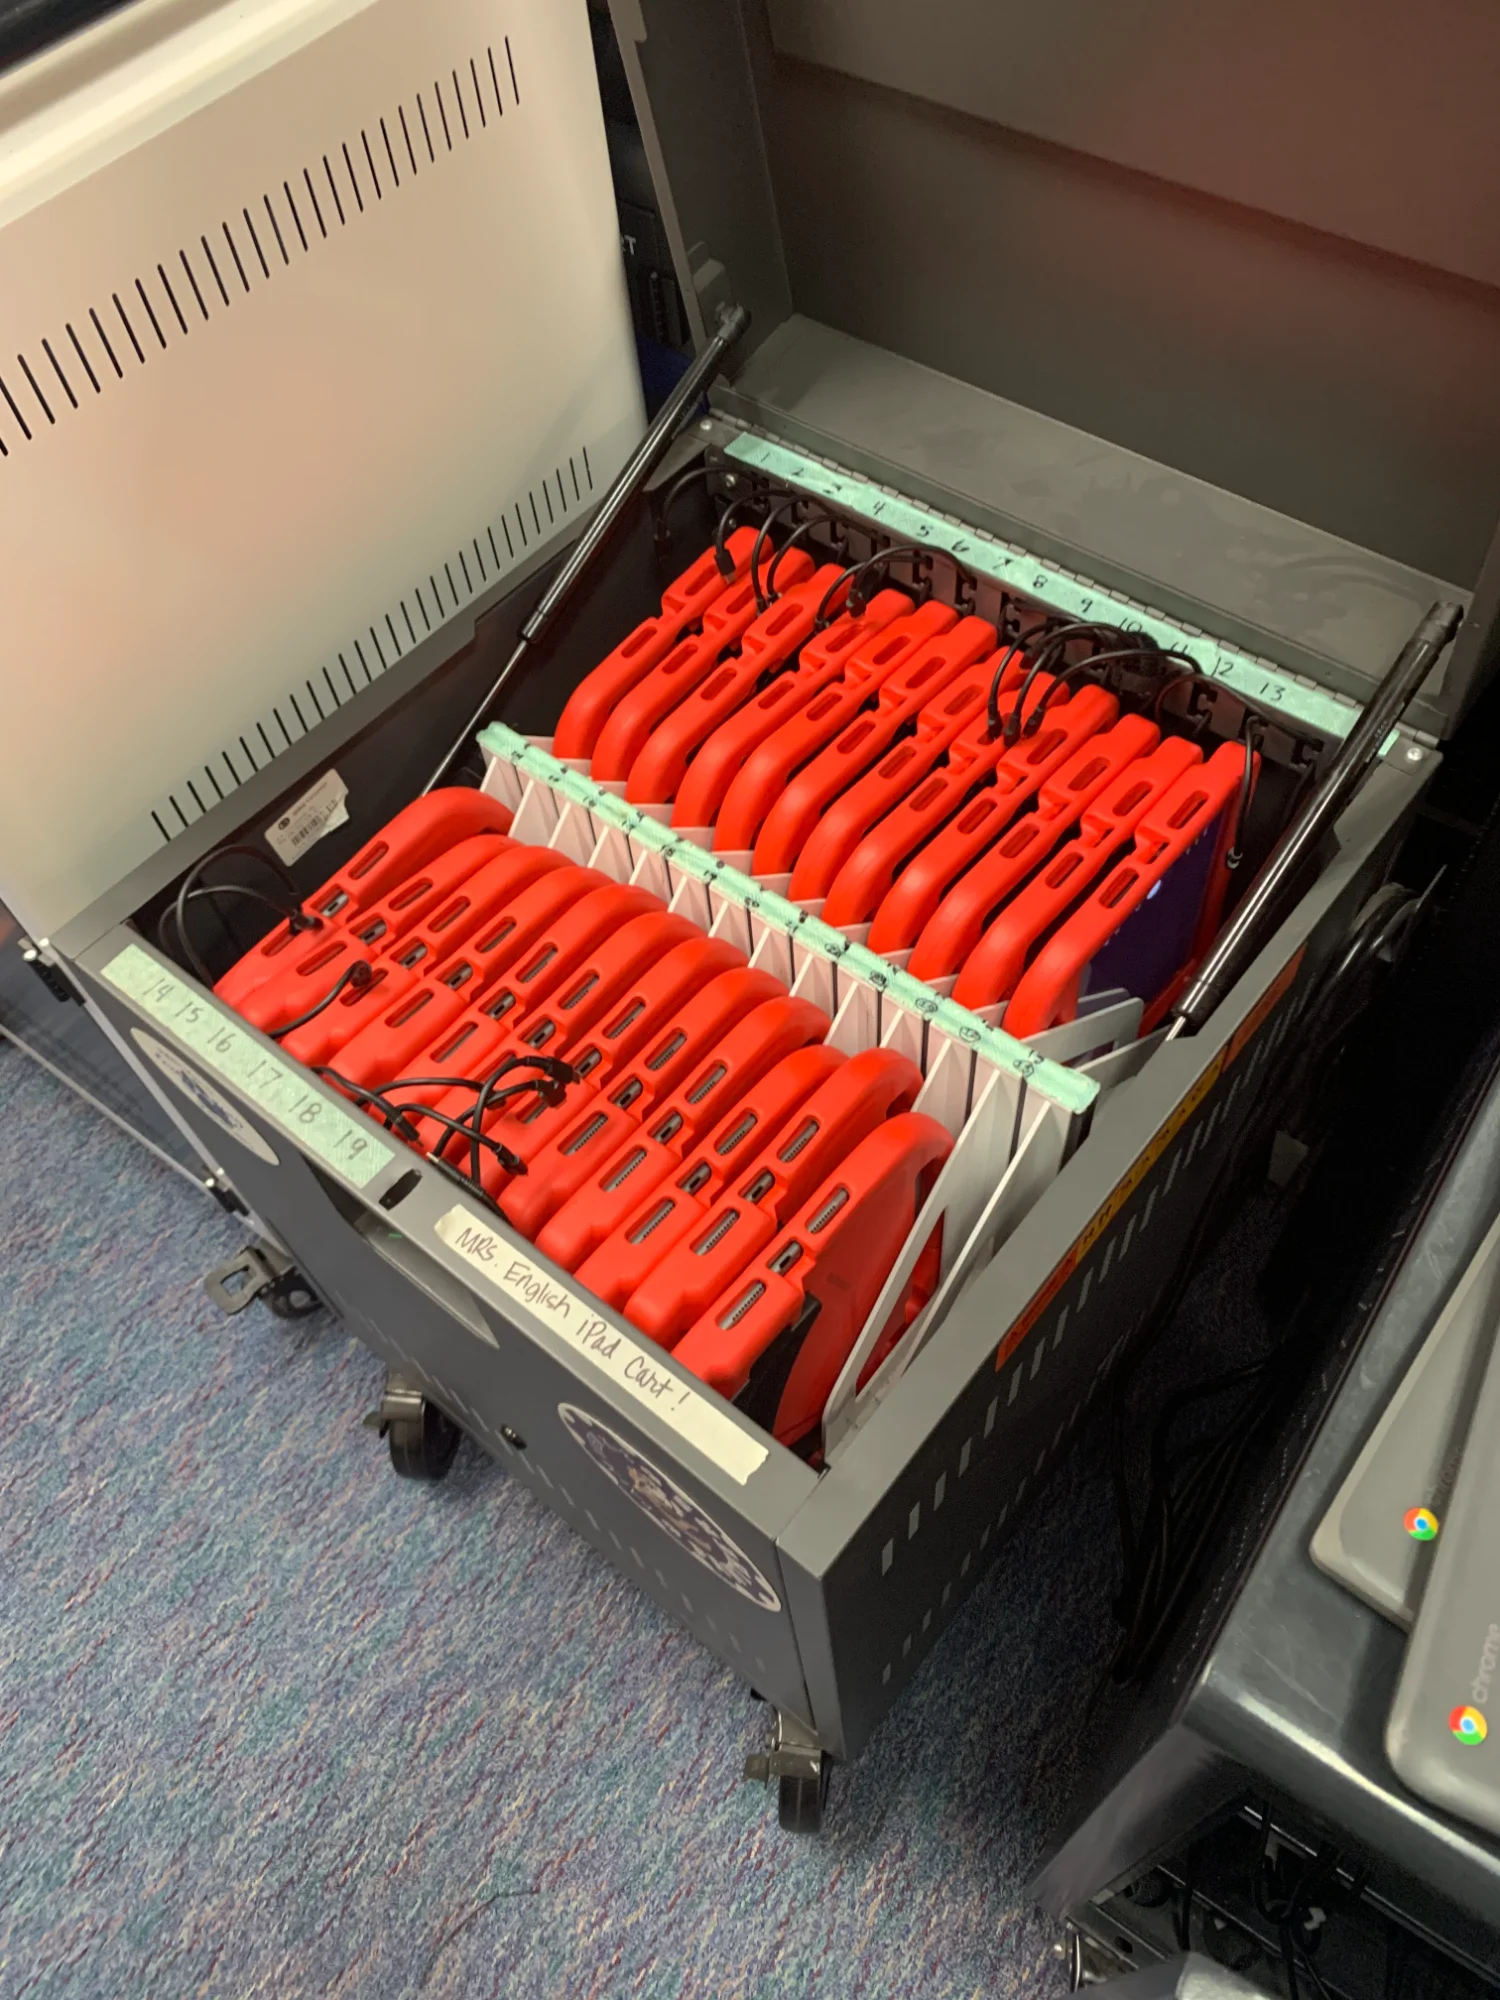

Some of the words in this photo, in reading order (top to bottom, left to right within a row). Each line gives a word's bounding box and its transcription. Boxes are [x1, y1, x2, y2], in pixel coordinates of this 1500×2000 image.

[872, 500, 887, 516] 4
[916, 523, 934, 538] 5
[950, 539, 970, 553] 6
[1032, 573, 1049, 589] 8
[1080, 597, 1093, 613] 9
[1118, 616, 1143, 633] 10
[1211, 656, 1234, 677] 12
[1259, 681, 1286, 701] 13
[142, 976, 175, 1003] 14
[174, 1000, 205, 1024] 15
[206, 1026, 237, 1054] 16
[247, 1059, 283, 1089] 17
[287, 1094, 323, 1124] 18
[332, 1128, 368, 1160] 19
[502, 1260, 572, 1319] English
[574, 1313, 621, 1360] iPad
